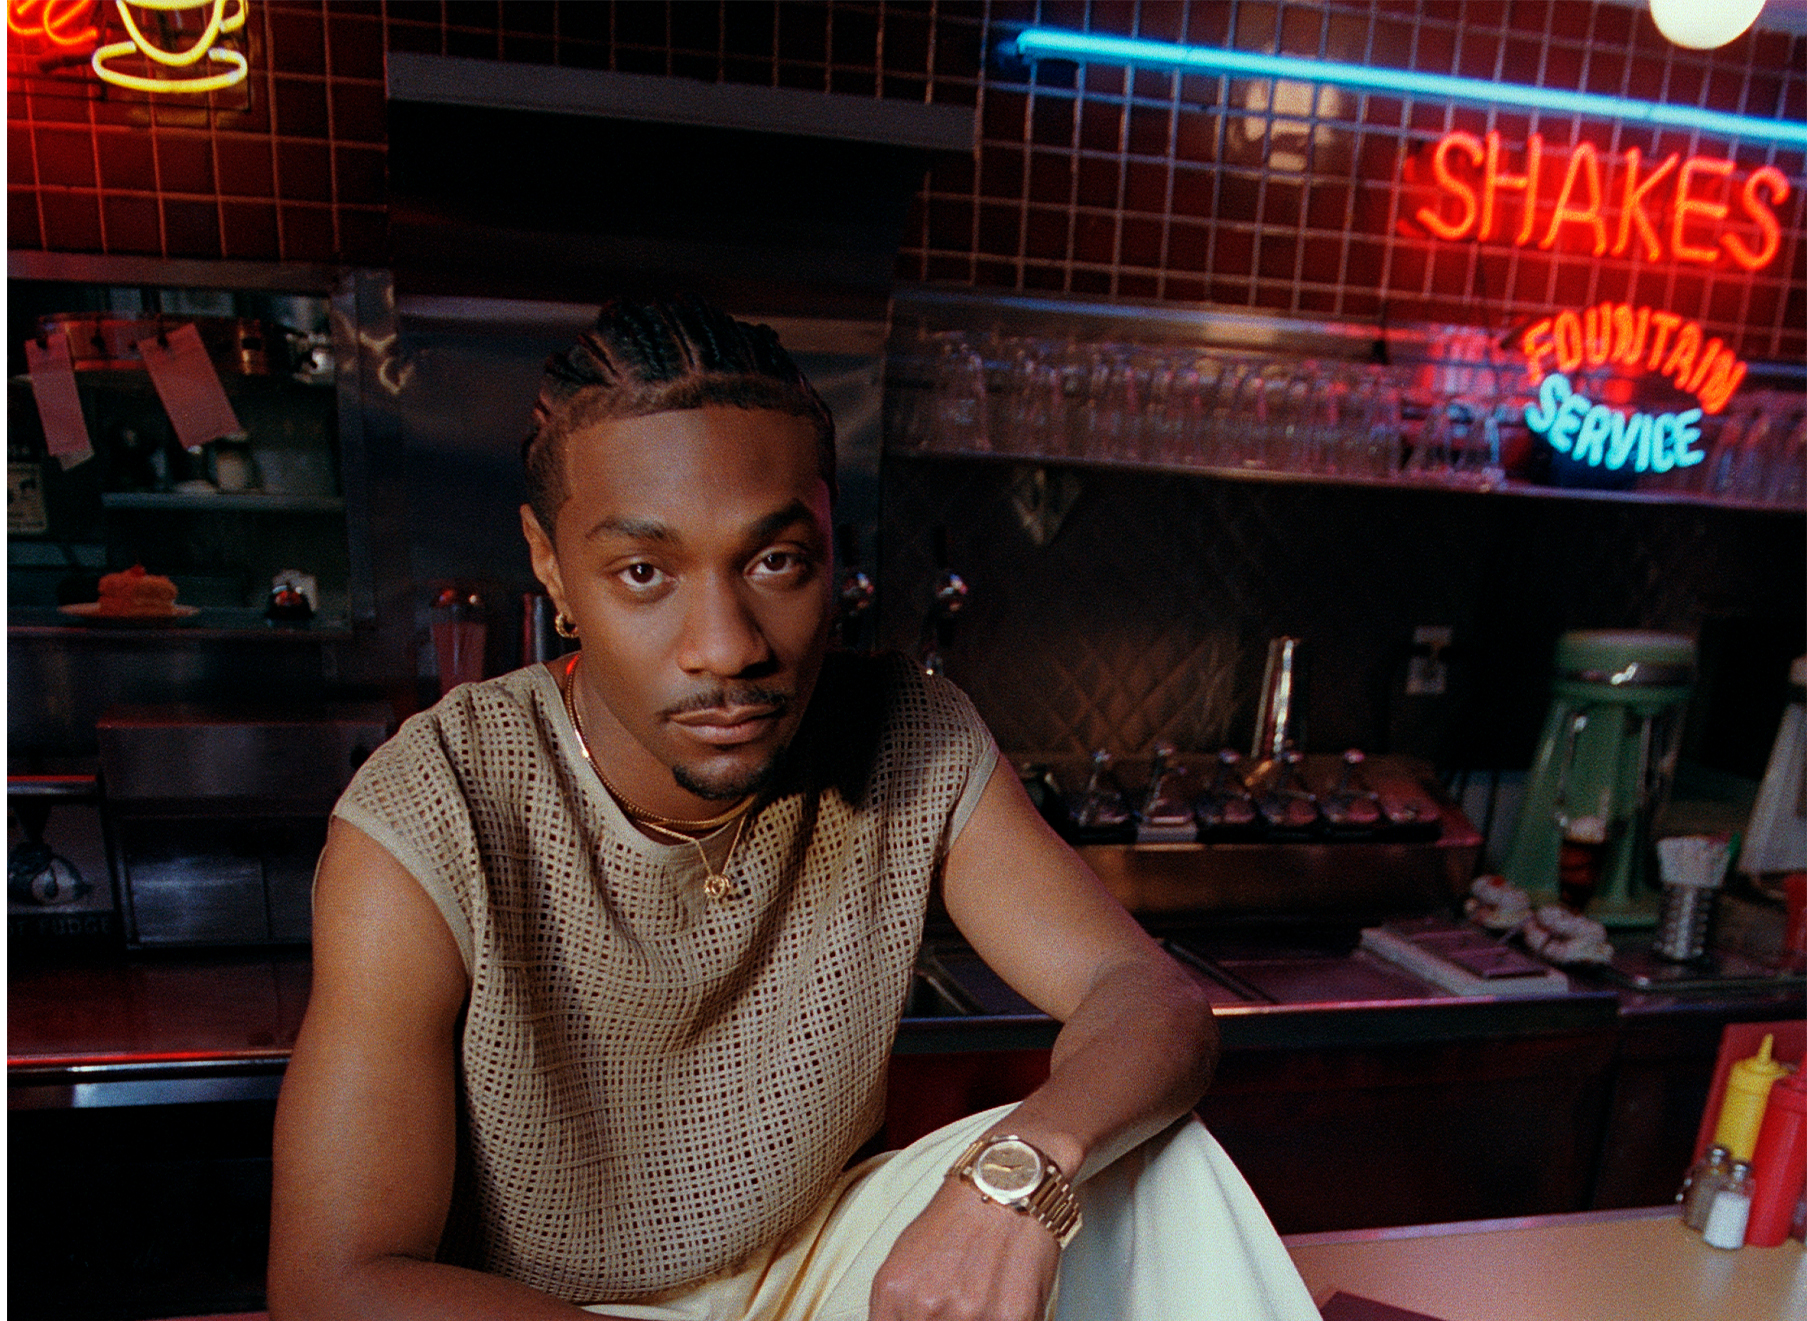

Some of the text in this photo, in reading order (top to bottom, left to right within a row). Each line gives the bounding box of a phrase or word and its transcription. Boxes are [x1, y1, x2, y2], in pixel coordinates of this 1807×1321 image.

[1416, 130, 1792, 270] SHAKES
[1524, 302, 1748, 415] FOUNTAIN
[1525, 373, 1706, 474] SERVICE
[37, 916, 112, 936] FUDGE
